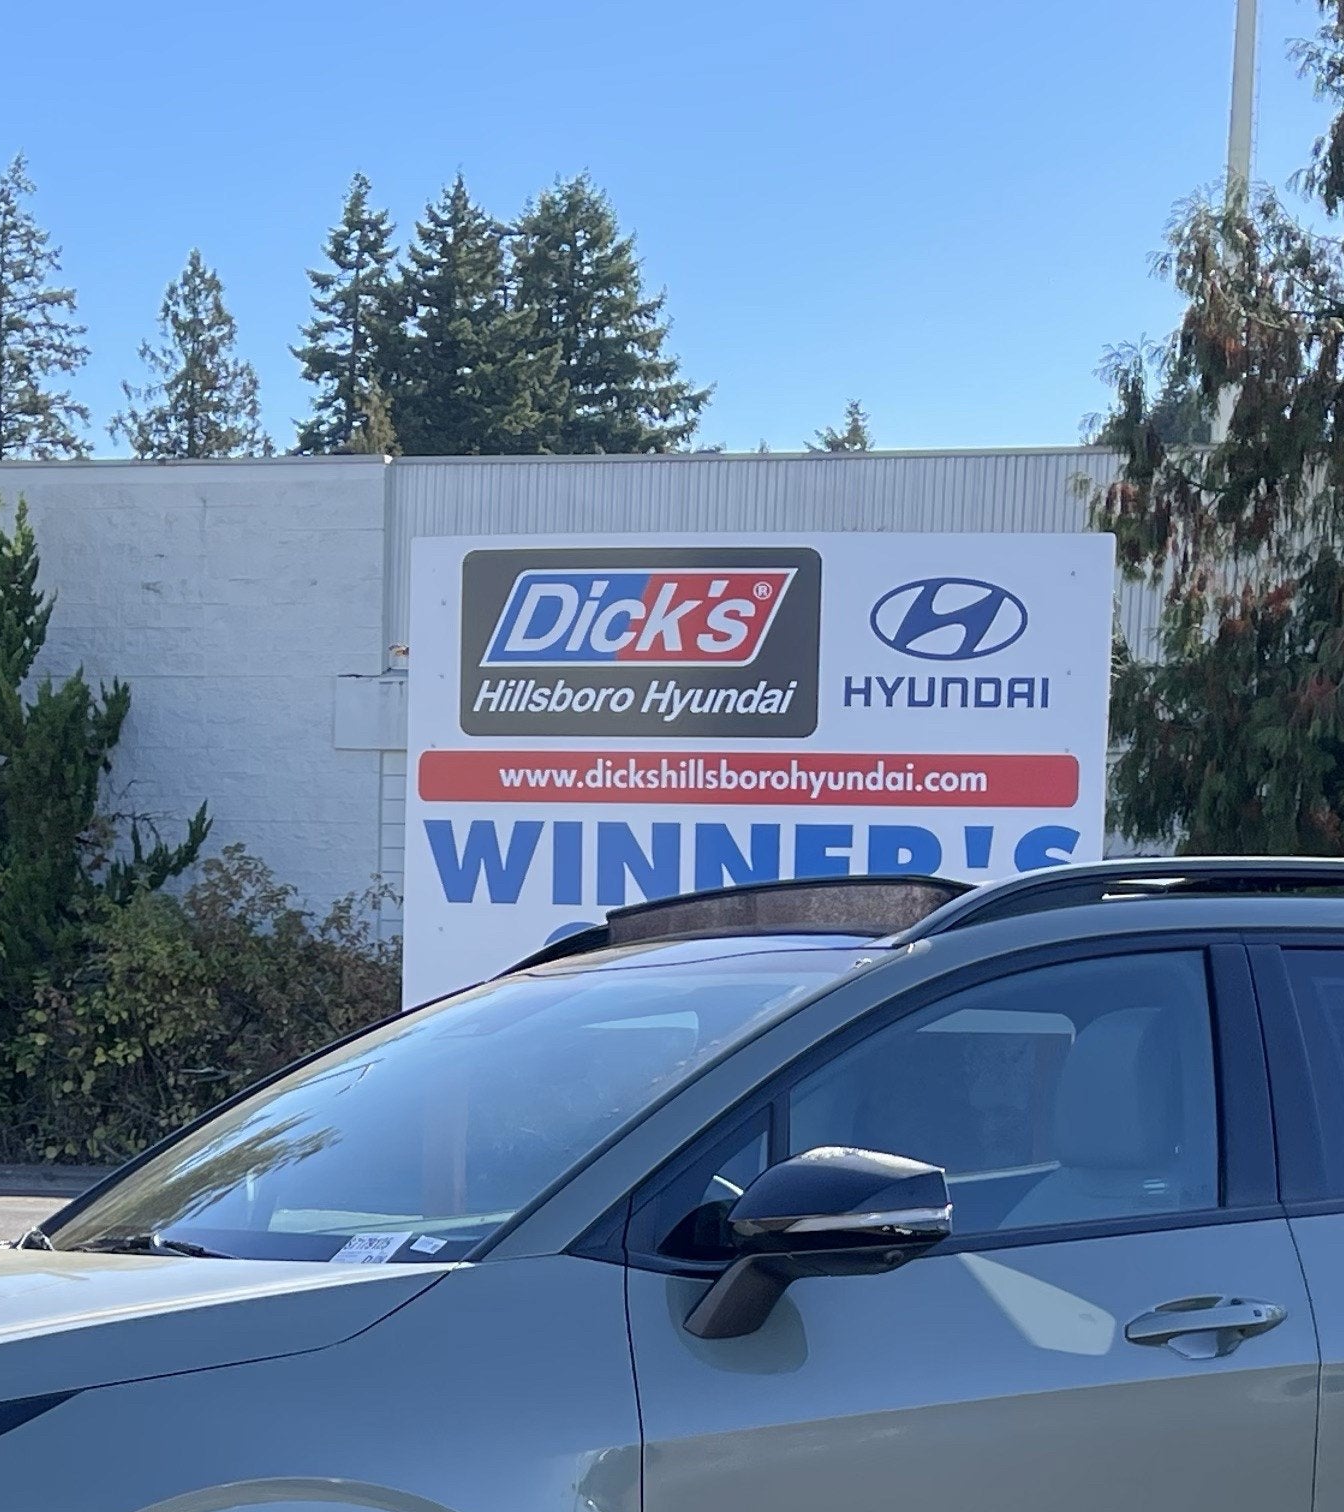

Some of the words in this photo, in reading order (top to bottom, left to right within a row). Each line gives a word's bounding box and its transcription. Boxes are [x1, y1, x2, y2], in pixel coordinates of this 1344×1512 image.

[472, 679, 634, 714] Hillsboro
[639, 680, 797, 722] Hyundai
[844, 675, 1050, 710] HYUNDAI
[499, 758, 989, 799] www.dickshillsborohyundai.com
